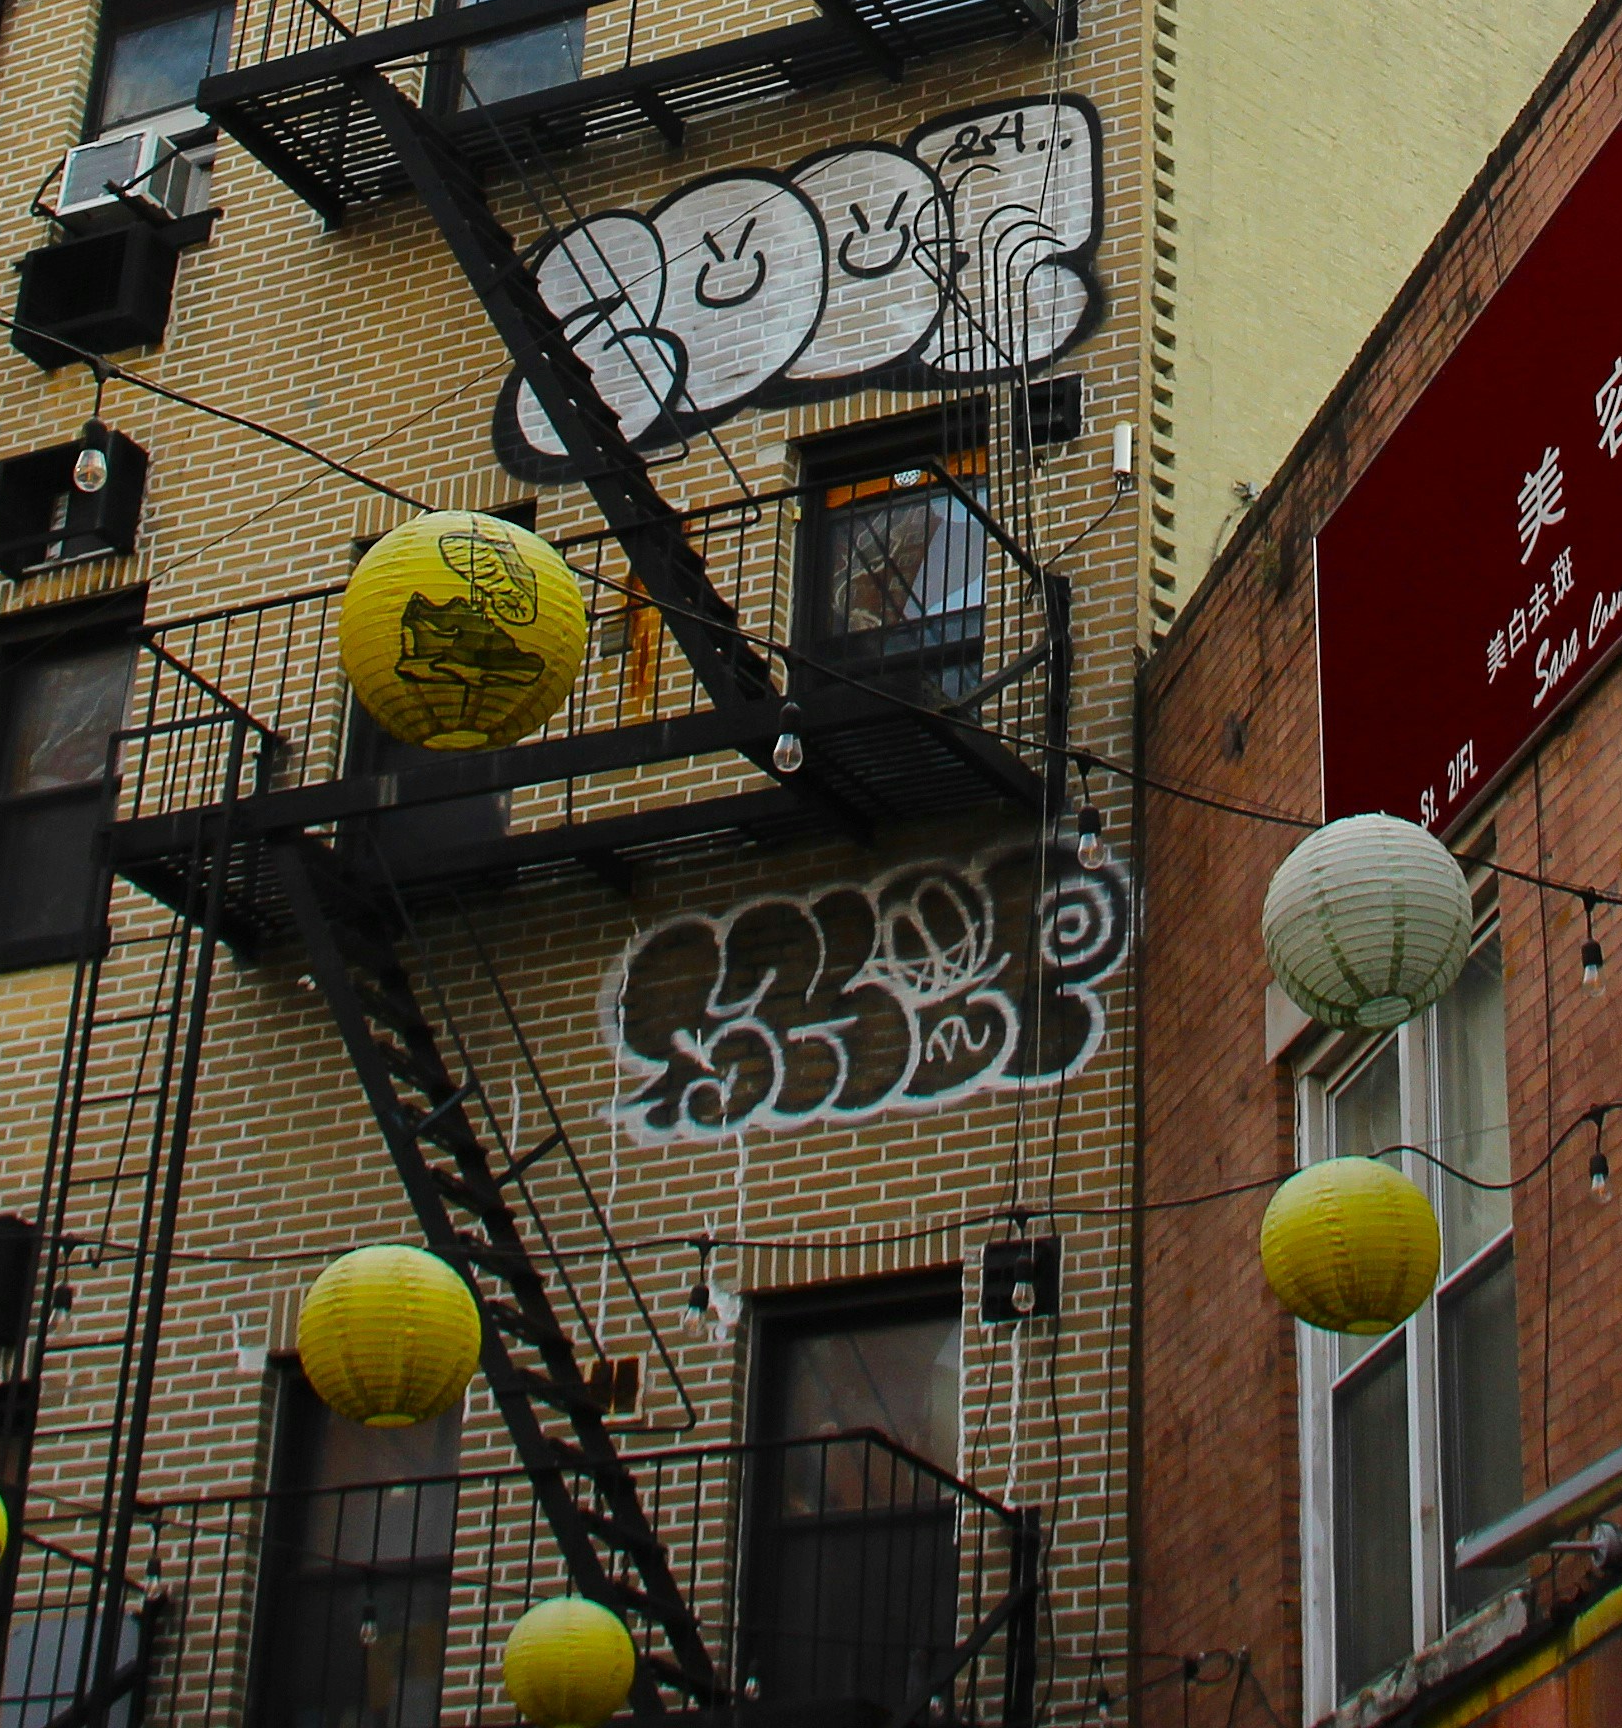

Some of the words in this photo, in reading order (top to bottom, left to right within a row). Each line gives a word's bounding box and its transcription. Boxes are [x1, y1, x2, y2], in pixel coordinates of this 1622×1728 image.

[1487, 546, 1574, 683] 美白去斑
[1534, 628, 1579, 708] Sasa
[1421, 786, 1438, 831] St.
[1448, 740, 1478, 801] 2/FL
